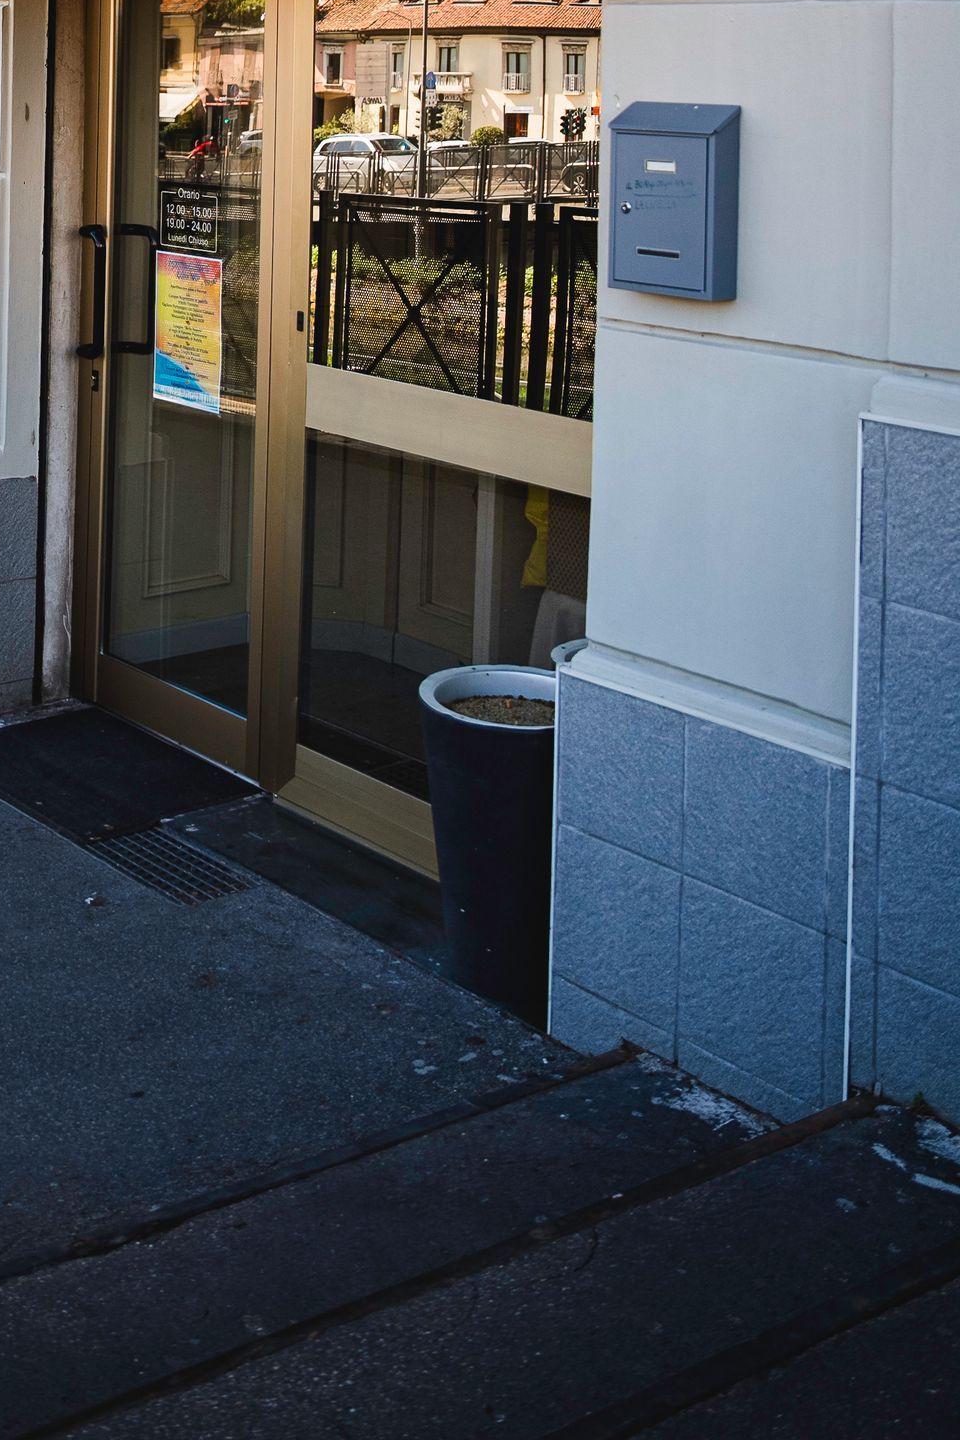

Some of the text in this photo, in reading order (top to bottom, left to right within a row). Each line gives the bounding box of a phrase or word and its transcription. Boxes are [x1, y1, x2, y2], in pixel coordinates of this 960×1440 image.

[177, 187, 200, 200] Orario
[166, 203, 186, 215] 12.00
[192, 206, 212, 218] 15.00
[166, 217, 186, 230] 19.00
[191, 220, 212, 233] 24.00
[188, 235, 209, 246] Chiuso
